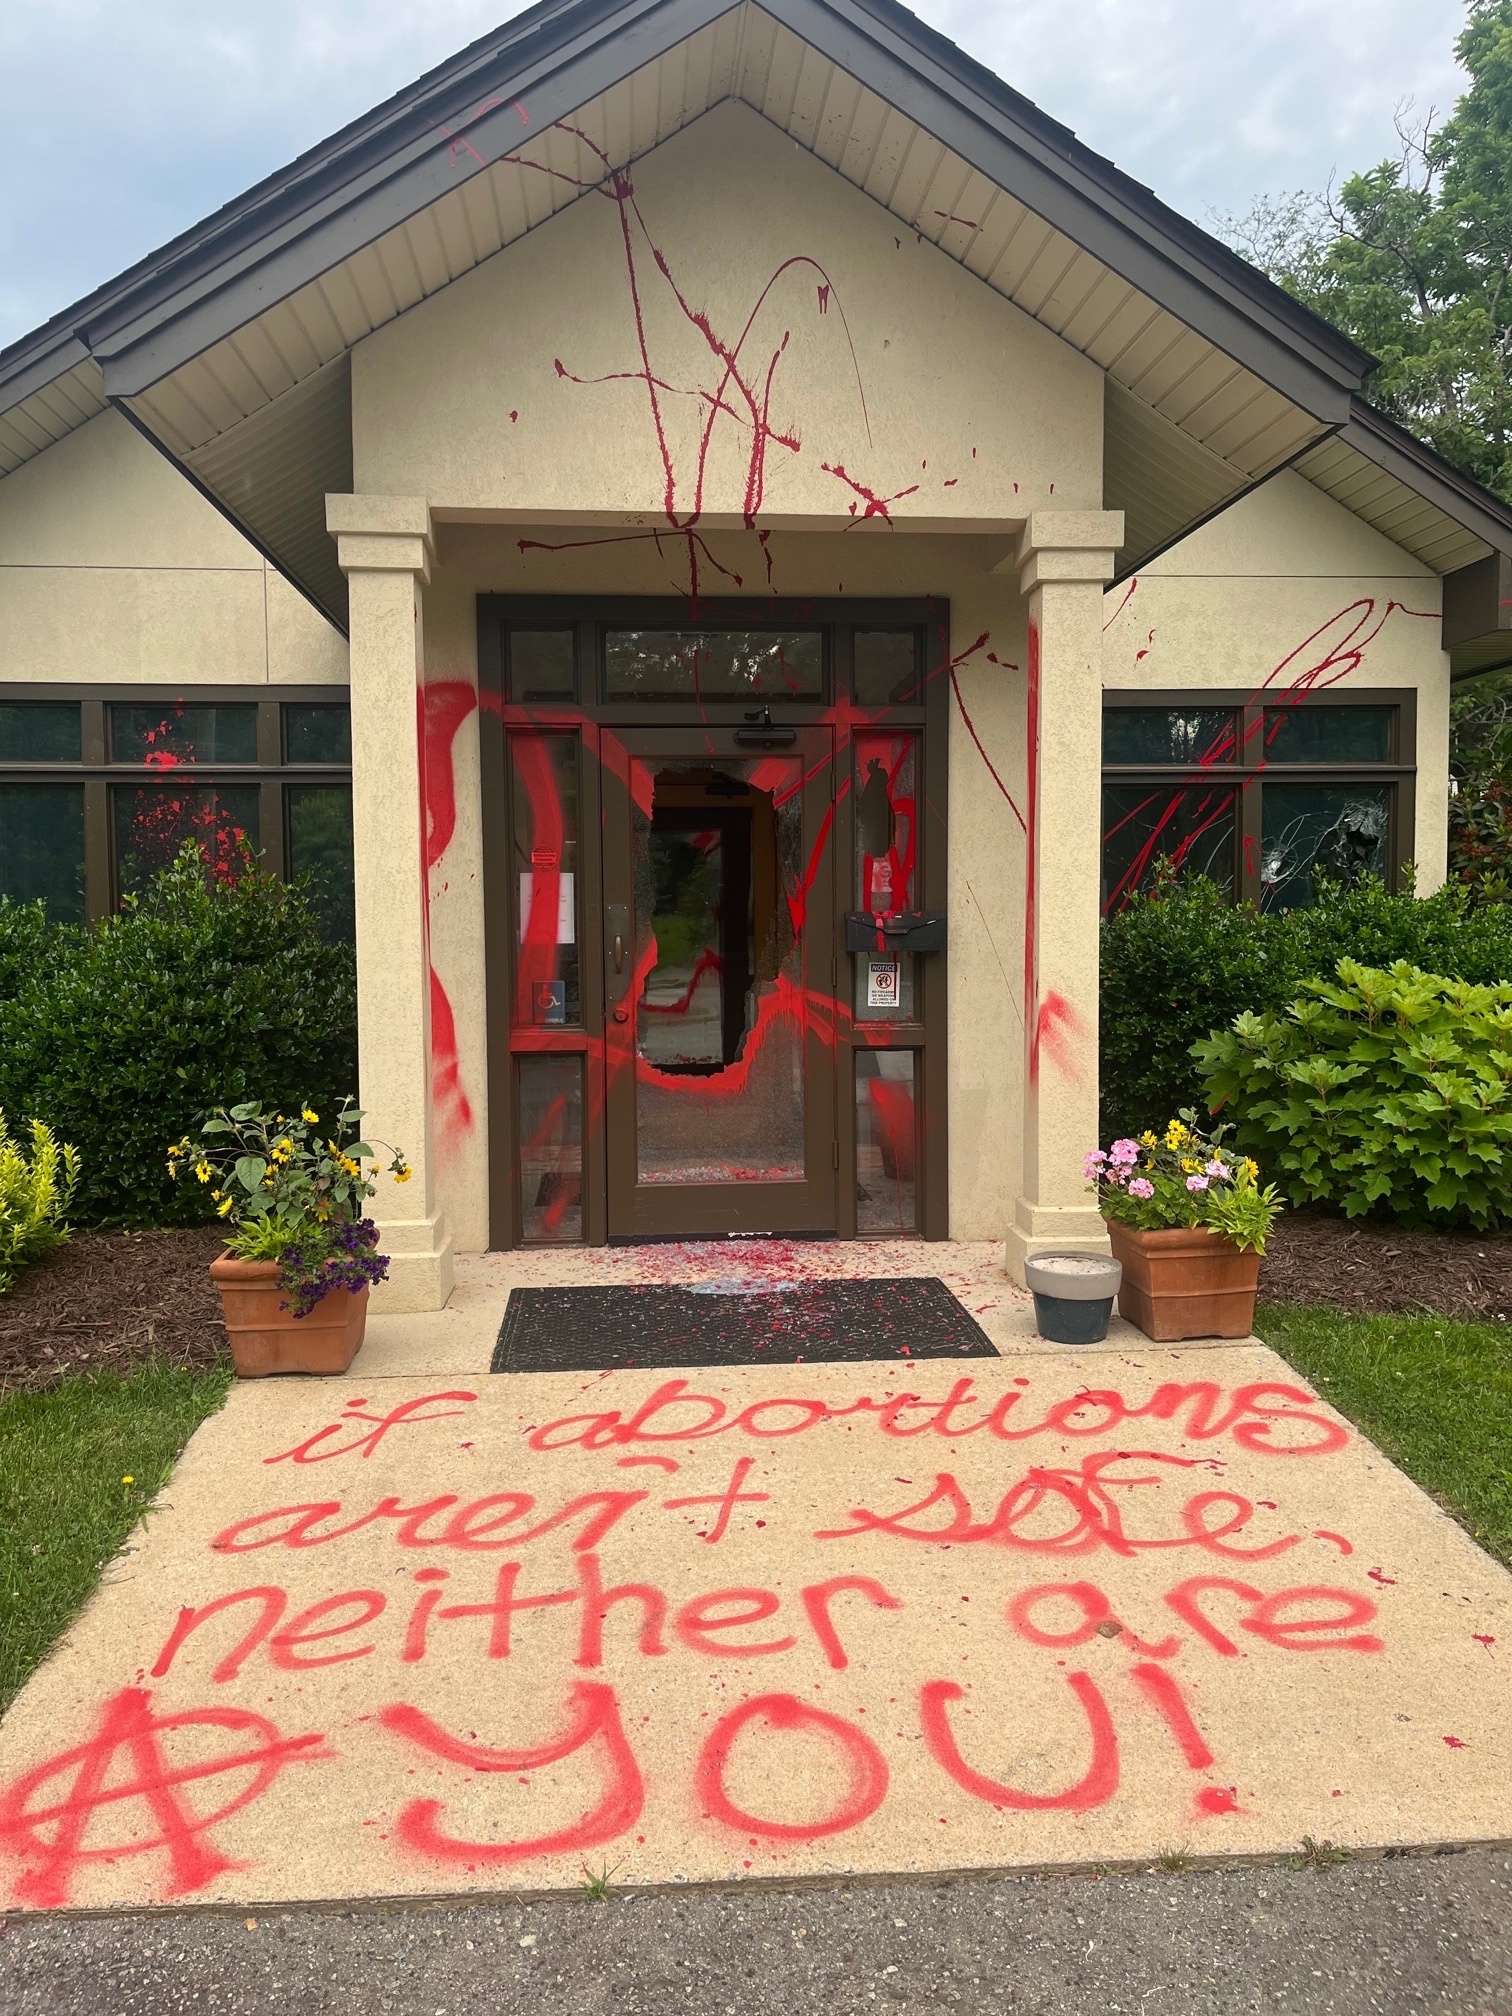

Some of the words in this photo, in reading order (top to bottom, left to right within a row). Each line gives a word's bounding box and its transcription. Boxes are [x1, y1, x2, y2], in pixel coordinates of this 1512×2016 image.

[262, 1390, 479, 1464] if
[527, 1378, 1350, 1456] abortions
[210, 1455, 770, 1556] aren't
[150, 1553, 905, 1684] neither
[1006, 1574, 1386, 1660] are
[377, 1662, 1245, 1873] YOU!
